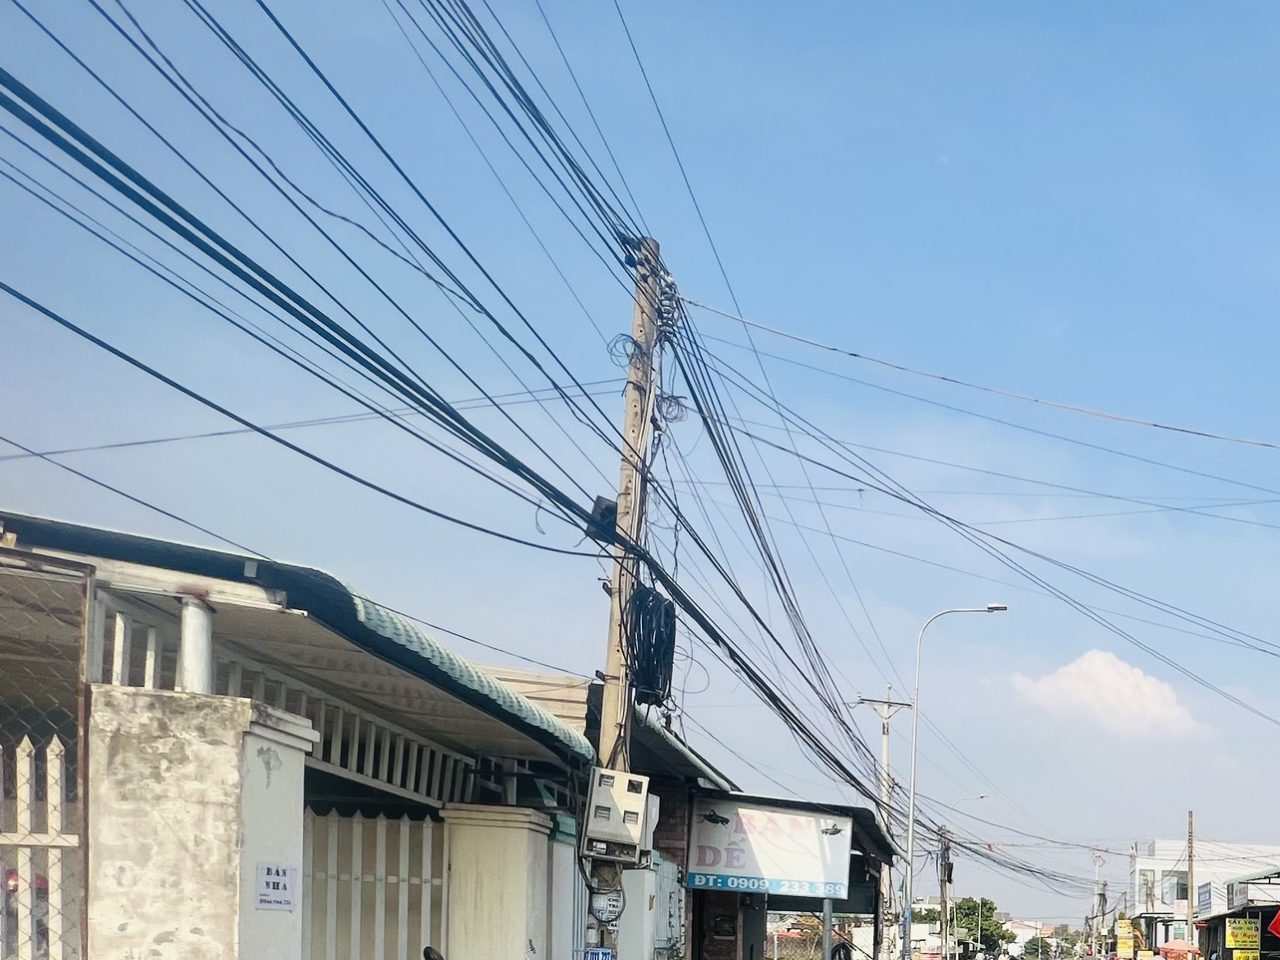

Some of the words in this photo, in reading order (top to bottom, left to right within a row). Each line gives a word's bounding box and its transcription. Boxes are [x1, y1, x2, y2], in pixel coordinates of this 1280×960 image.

[694, 874, 722, 887] ĐT:
[727, 877, 769, 890] 0909
[779, 880, 810, 893] 233
[816, 882, 846, 895] 389
